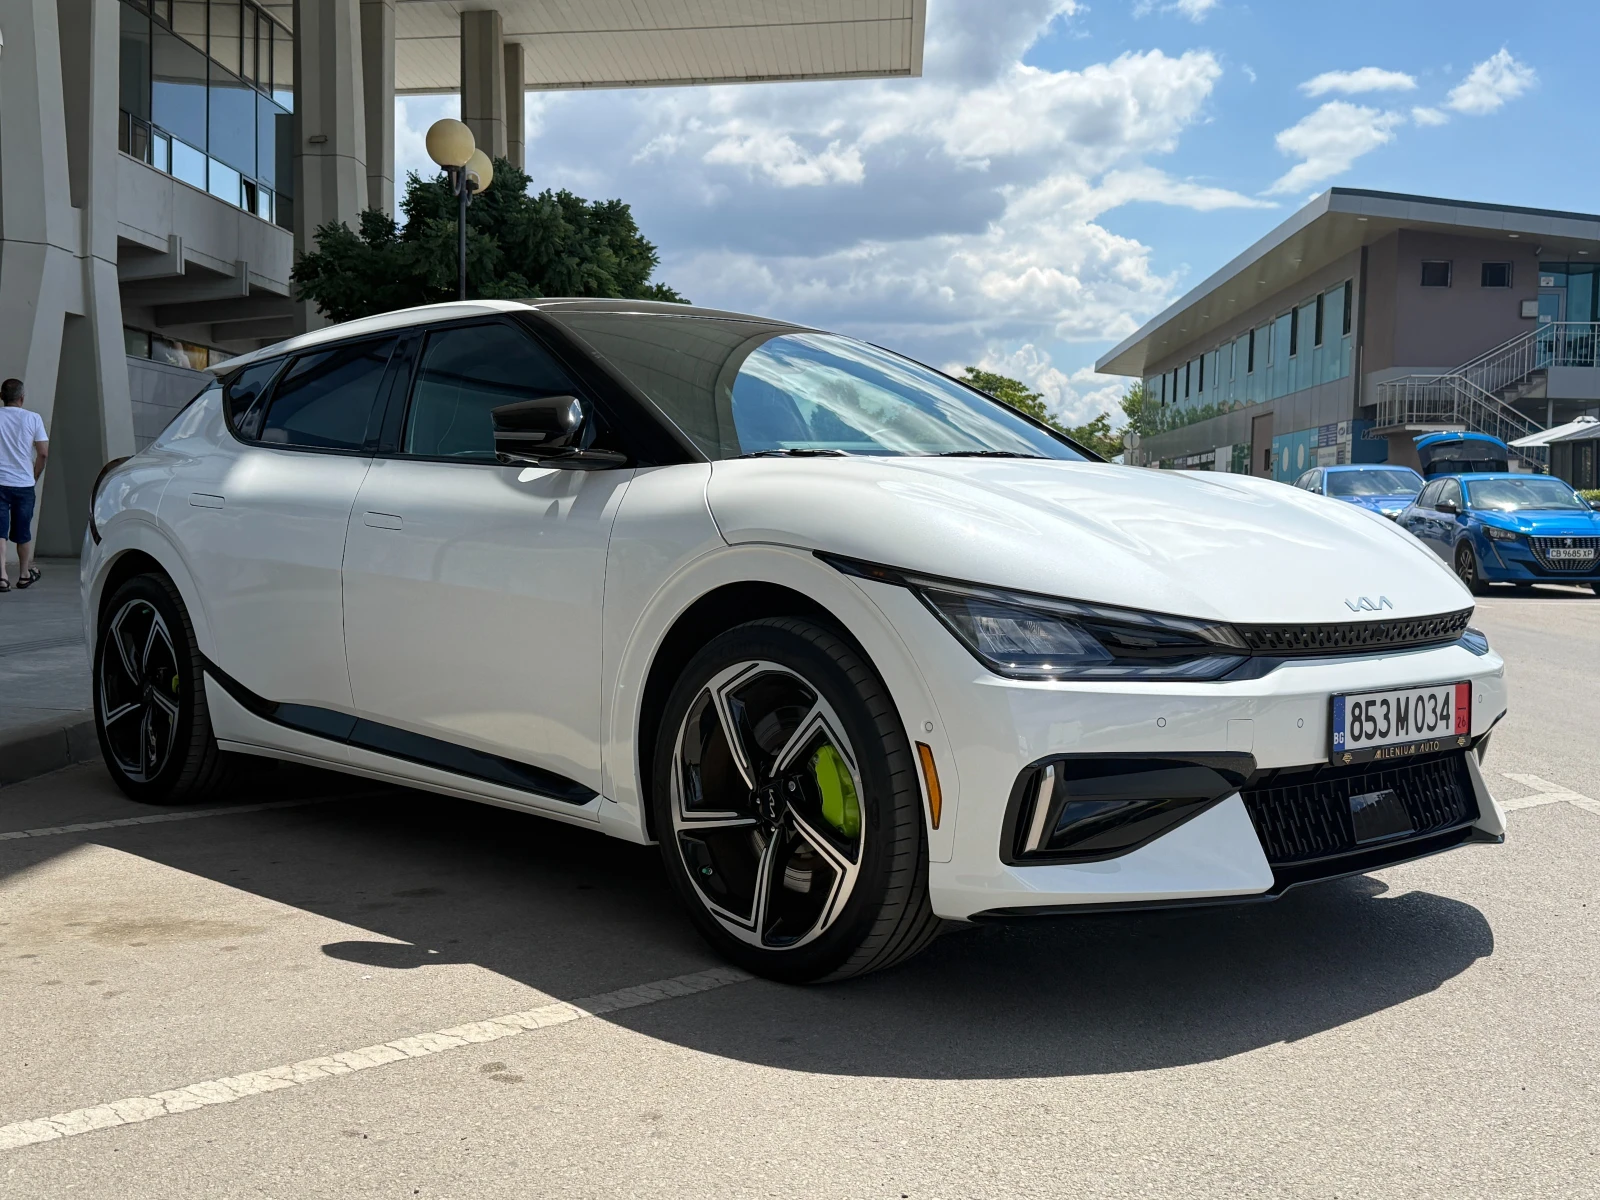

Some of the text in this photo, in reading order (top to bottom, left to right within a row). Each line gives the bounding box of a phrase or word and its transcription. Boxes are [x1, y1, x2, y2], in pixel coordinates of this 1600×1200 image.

[1551, 549, 1561, 558] CB
[1563, 549, 1581, 558] 9685
[1583, 549, 1593, 558] XP
[1344, 595, 1393, 612] KIA
[1350, 691, 1451, 742] 853 M 034
[1457, 716, 1467, 728] 26
[1333, 731, 1345, 745] BG
[1374, 740, 1440, 759] MILENIUM AUTO
